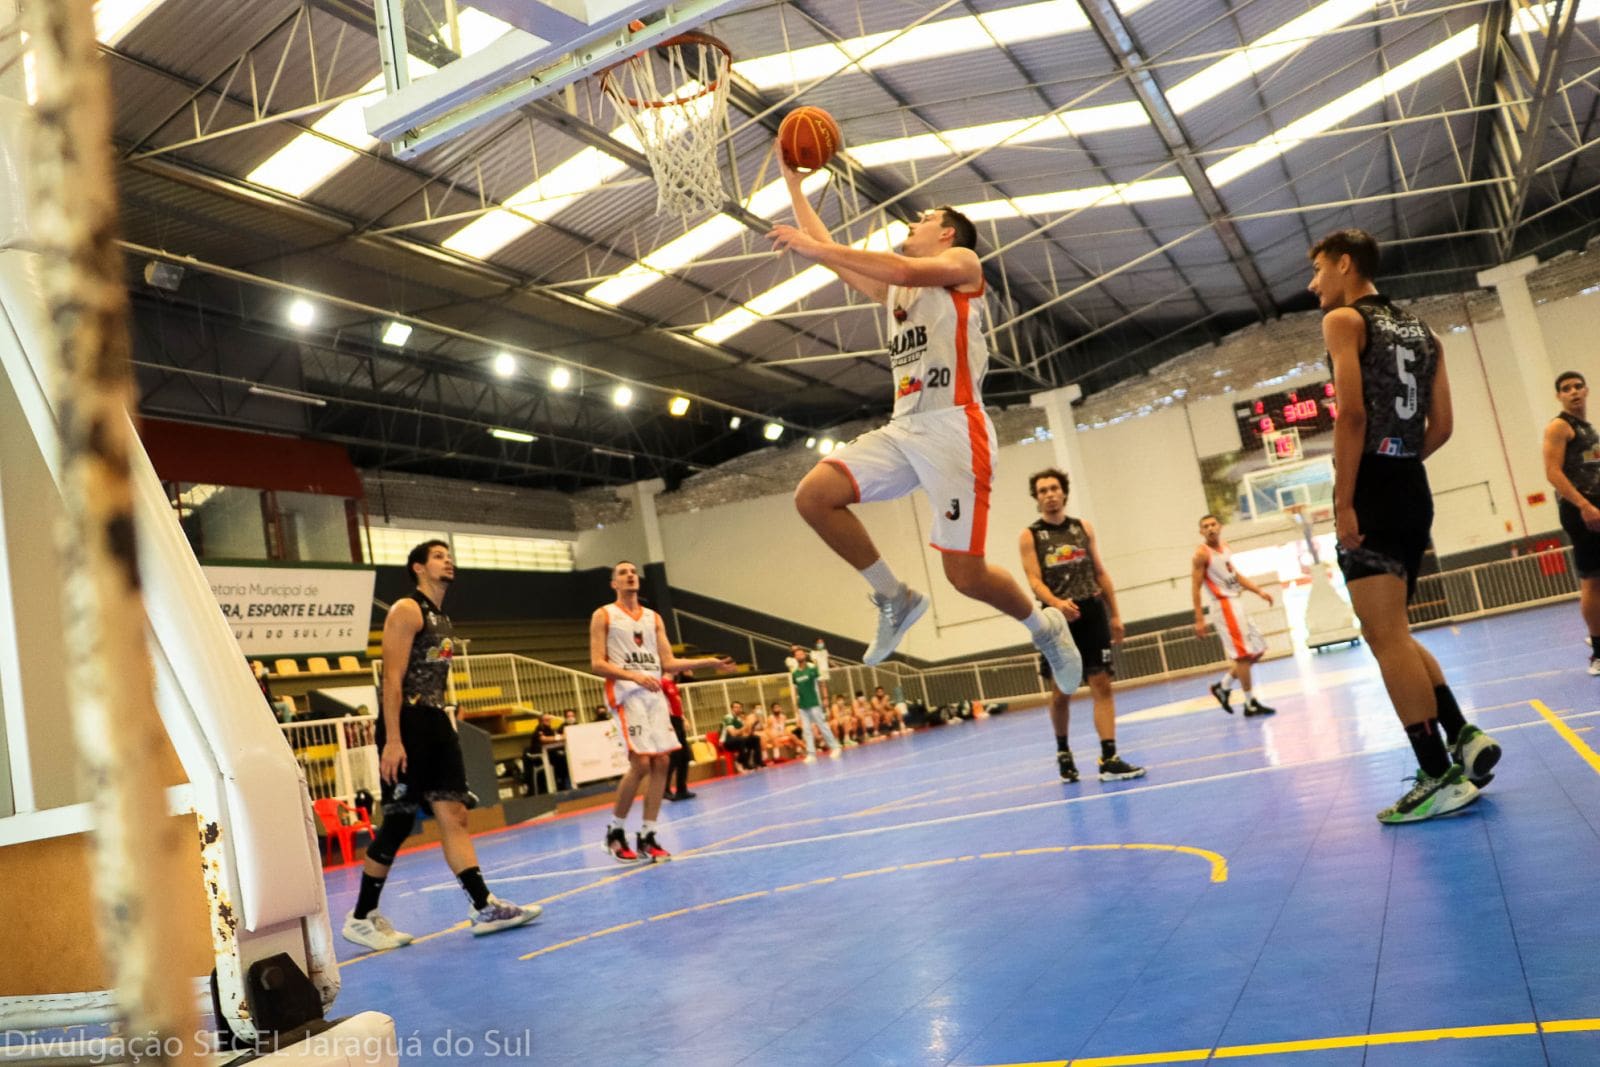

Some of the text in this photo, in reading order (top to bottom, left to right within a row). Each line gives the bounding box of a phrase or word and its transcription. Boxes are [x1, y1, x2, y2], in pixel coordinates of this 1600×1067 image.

[927, 367, 951, 388] 20
[1395, 343, 1417, 420] 5
[249, 583, 302, 598] Municipal
[304, 584, 319, 596] de
[219, 603, 355, 620] RA, ESPORTE E LAZER
[266, 629, 283, 639] DO
[293, 629, 319, 639] SUL
[339, 628, 353, 637] SC
[628, 725, 642, 737] 97
